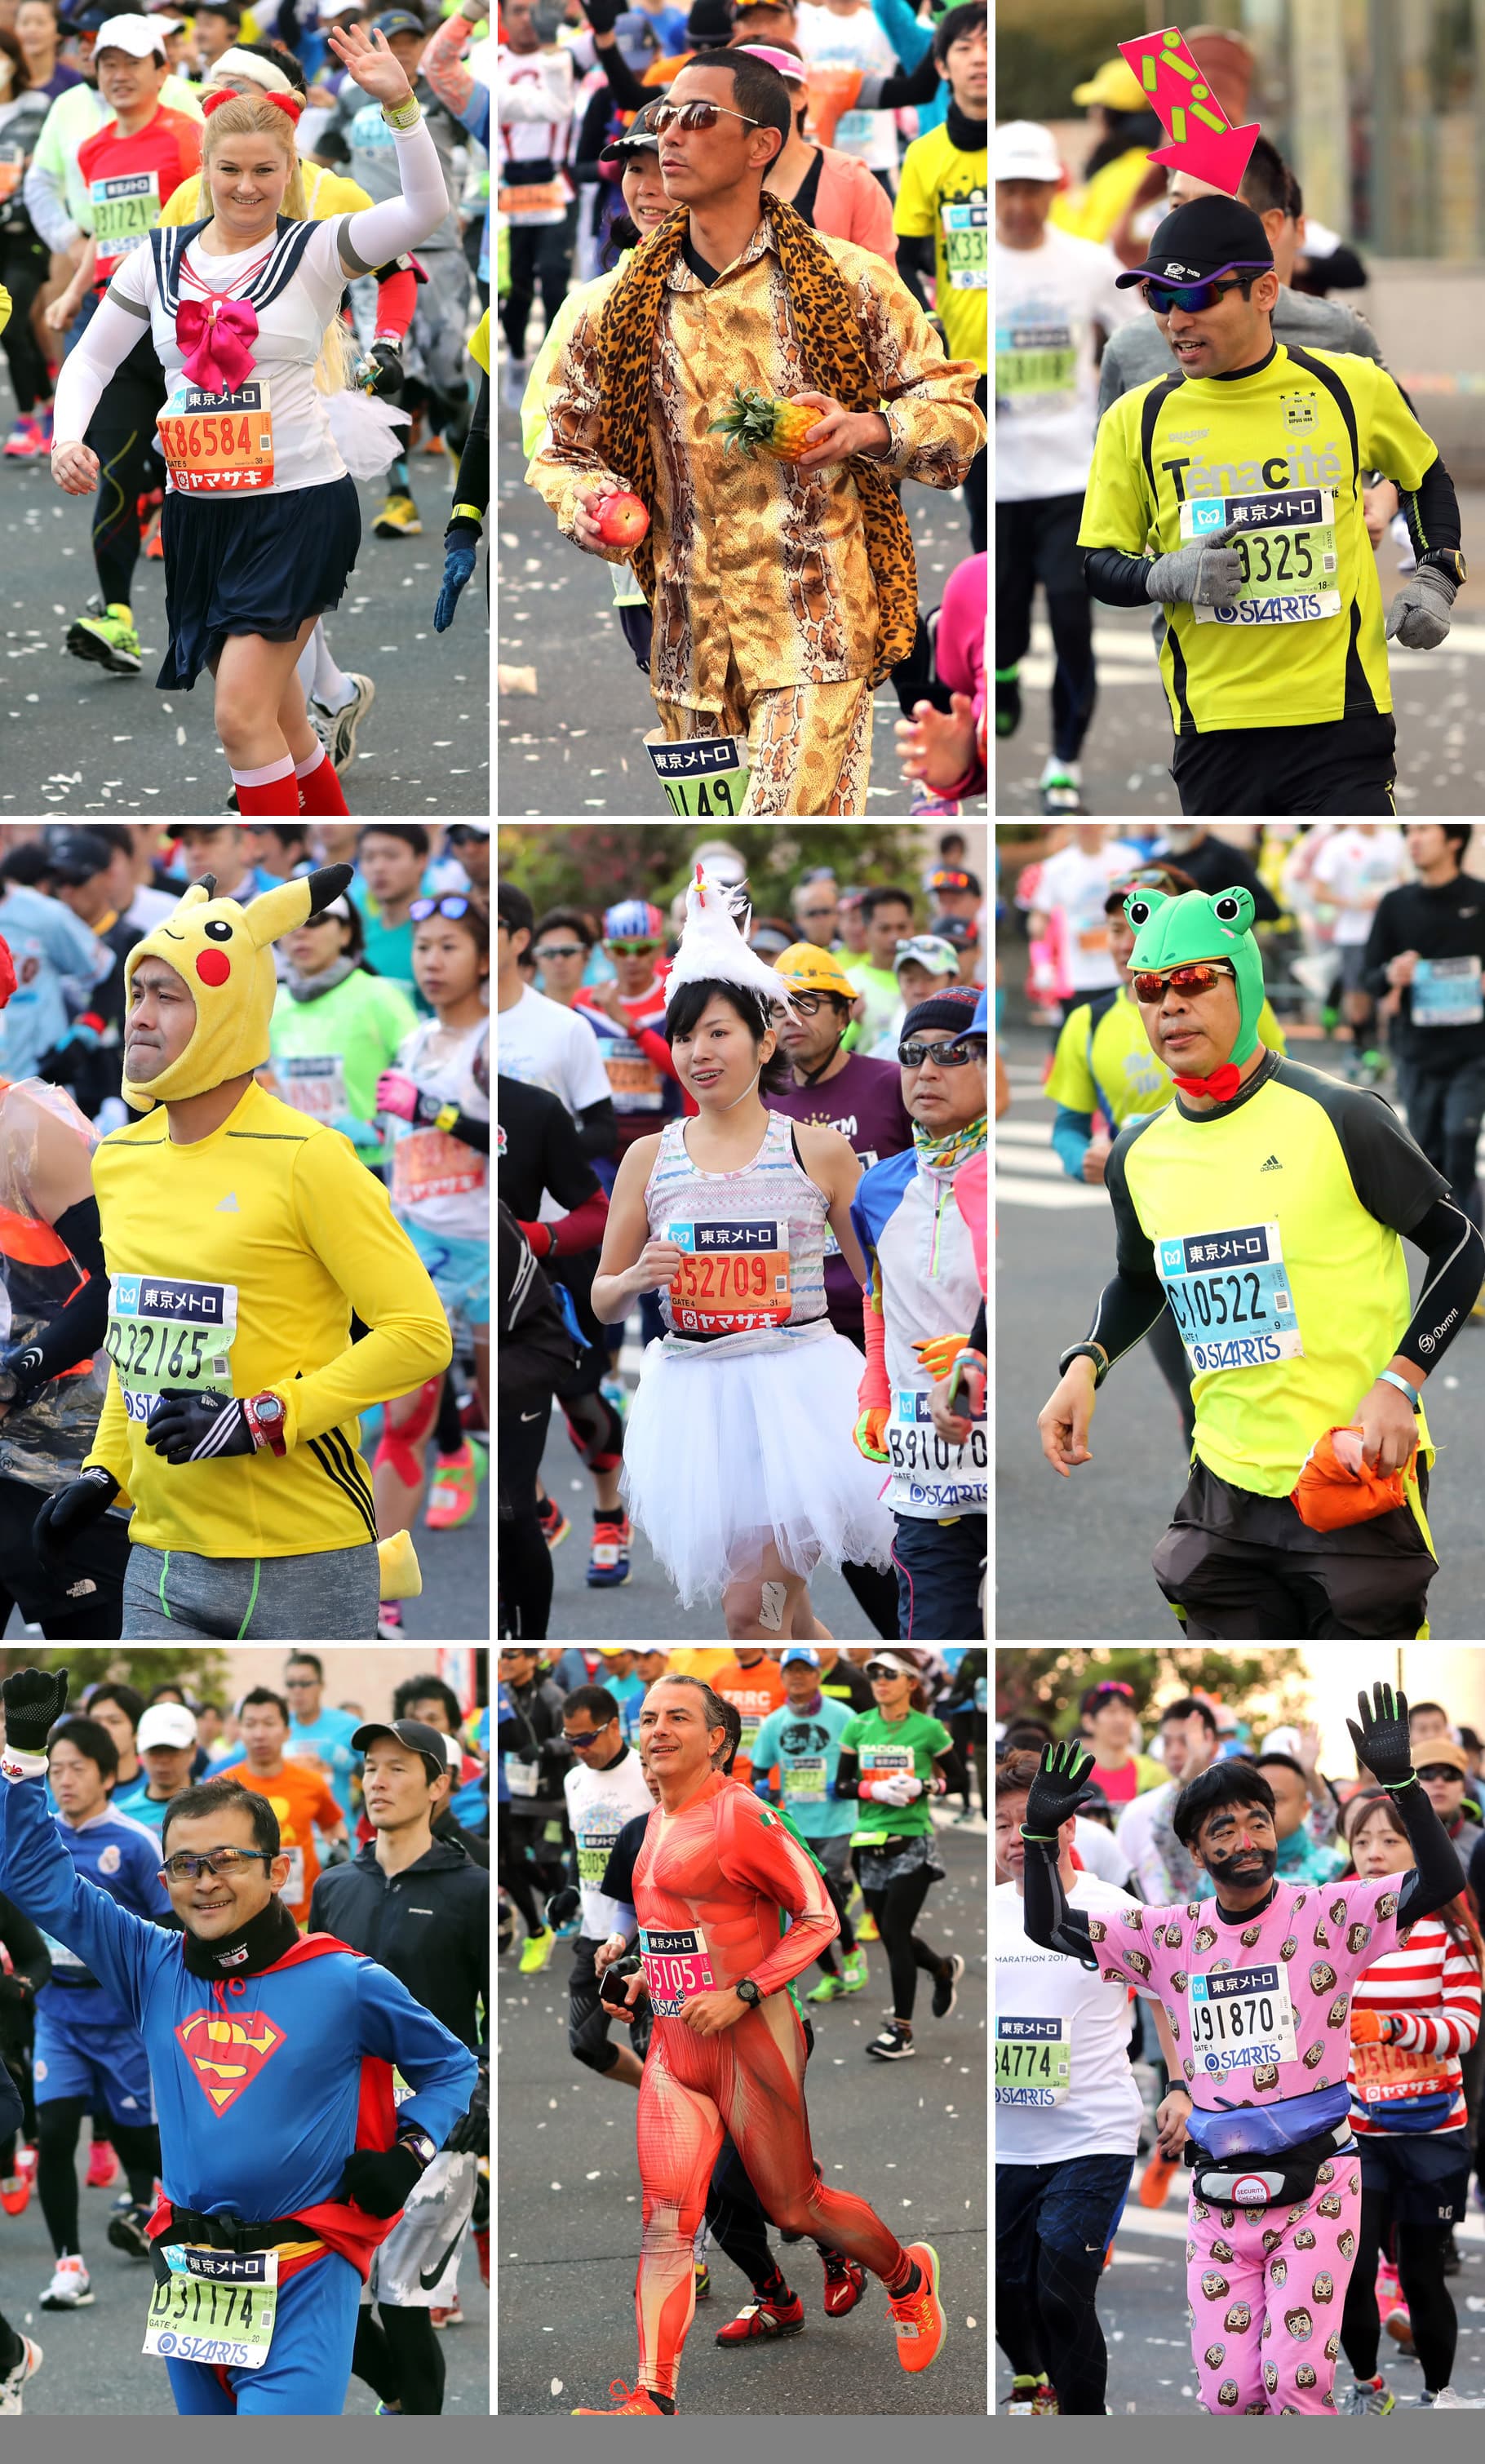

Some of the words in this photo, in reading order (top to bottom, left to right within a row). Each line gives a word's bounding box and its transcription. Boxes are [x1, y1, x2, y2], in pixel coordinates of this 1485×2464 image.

[948, 232, 987, 262] K33
[188, 389, 255, 407] 東京メトロ
[158, 416, 252, 459] K86584
[189, 470, 262, 488] ヤマザキ
[1232, 499, 1316, 523] 東京メトロ
[653, 745, 731, 769] 東京メトロ
[700, 1230, 772, 1244] 東京メトロ
[1189, 1237, 1261, 1264] 東京メトロ
[144, 1289, 216, 1314] 東京メトロ
[672, 1298, 690, 1307] GATE
[1167, 1272, 1267, 1329] C10522
[698, 1313, 778, 1329] ヤマザキ
[1274, 1320, 1281, 1330] 9
[1433, 1308, 1459, 1340] Doron
[649, 1937, 693, 1949] 東京メトロ
[995, 1954, 1045, 1963] MARATHON
[1048, 1954, 1069, 1962] 2017
[1212, 1972, 1274, 1993] 東京メトロ
[1001, 2022, 1057, 2035] 東京メトロ
[1193, 1997, 1274, 2042] J91870
[189, 2257, 259, 2275] 東京メトロ
[152, 2279, 253, 2329] D31174
[148, 2319, 171, 2329] GATE
[251, 2334, 260, 2343] 20
